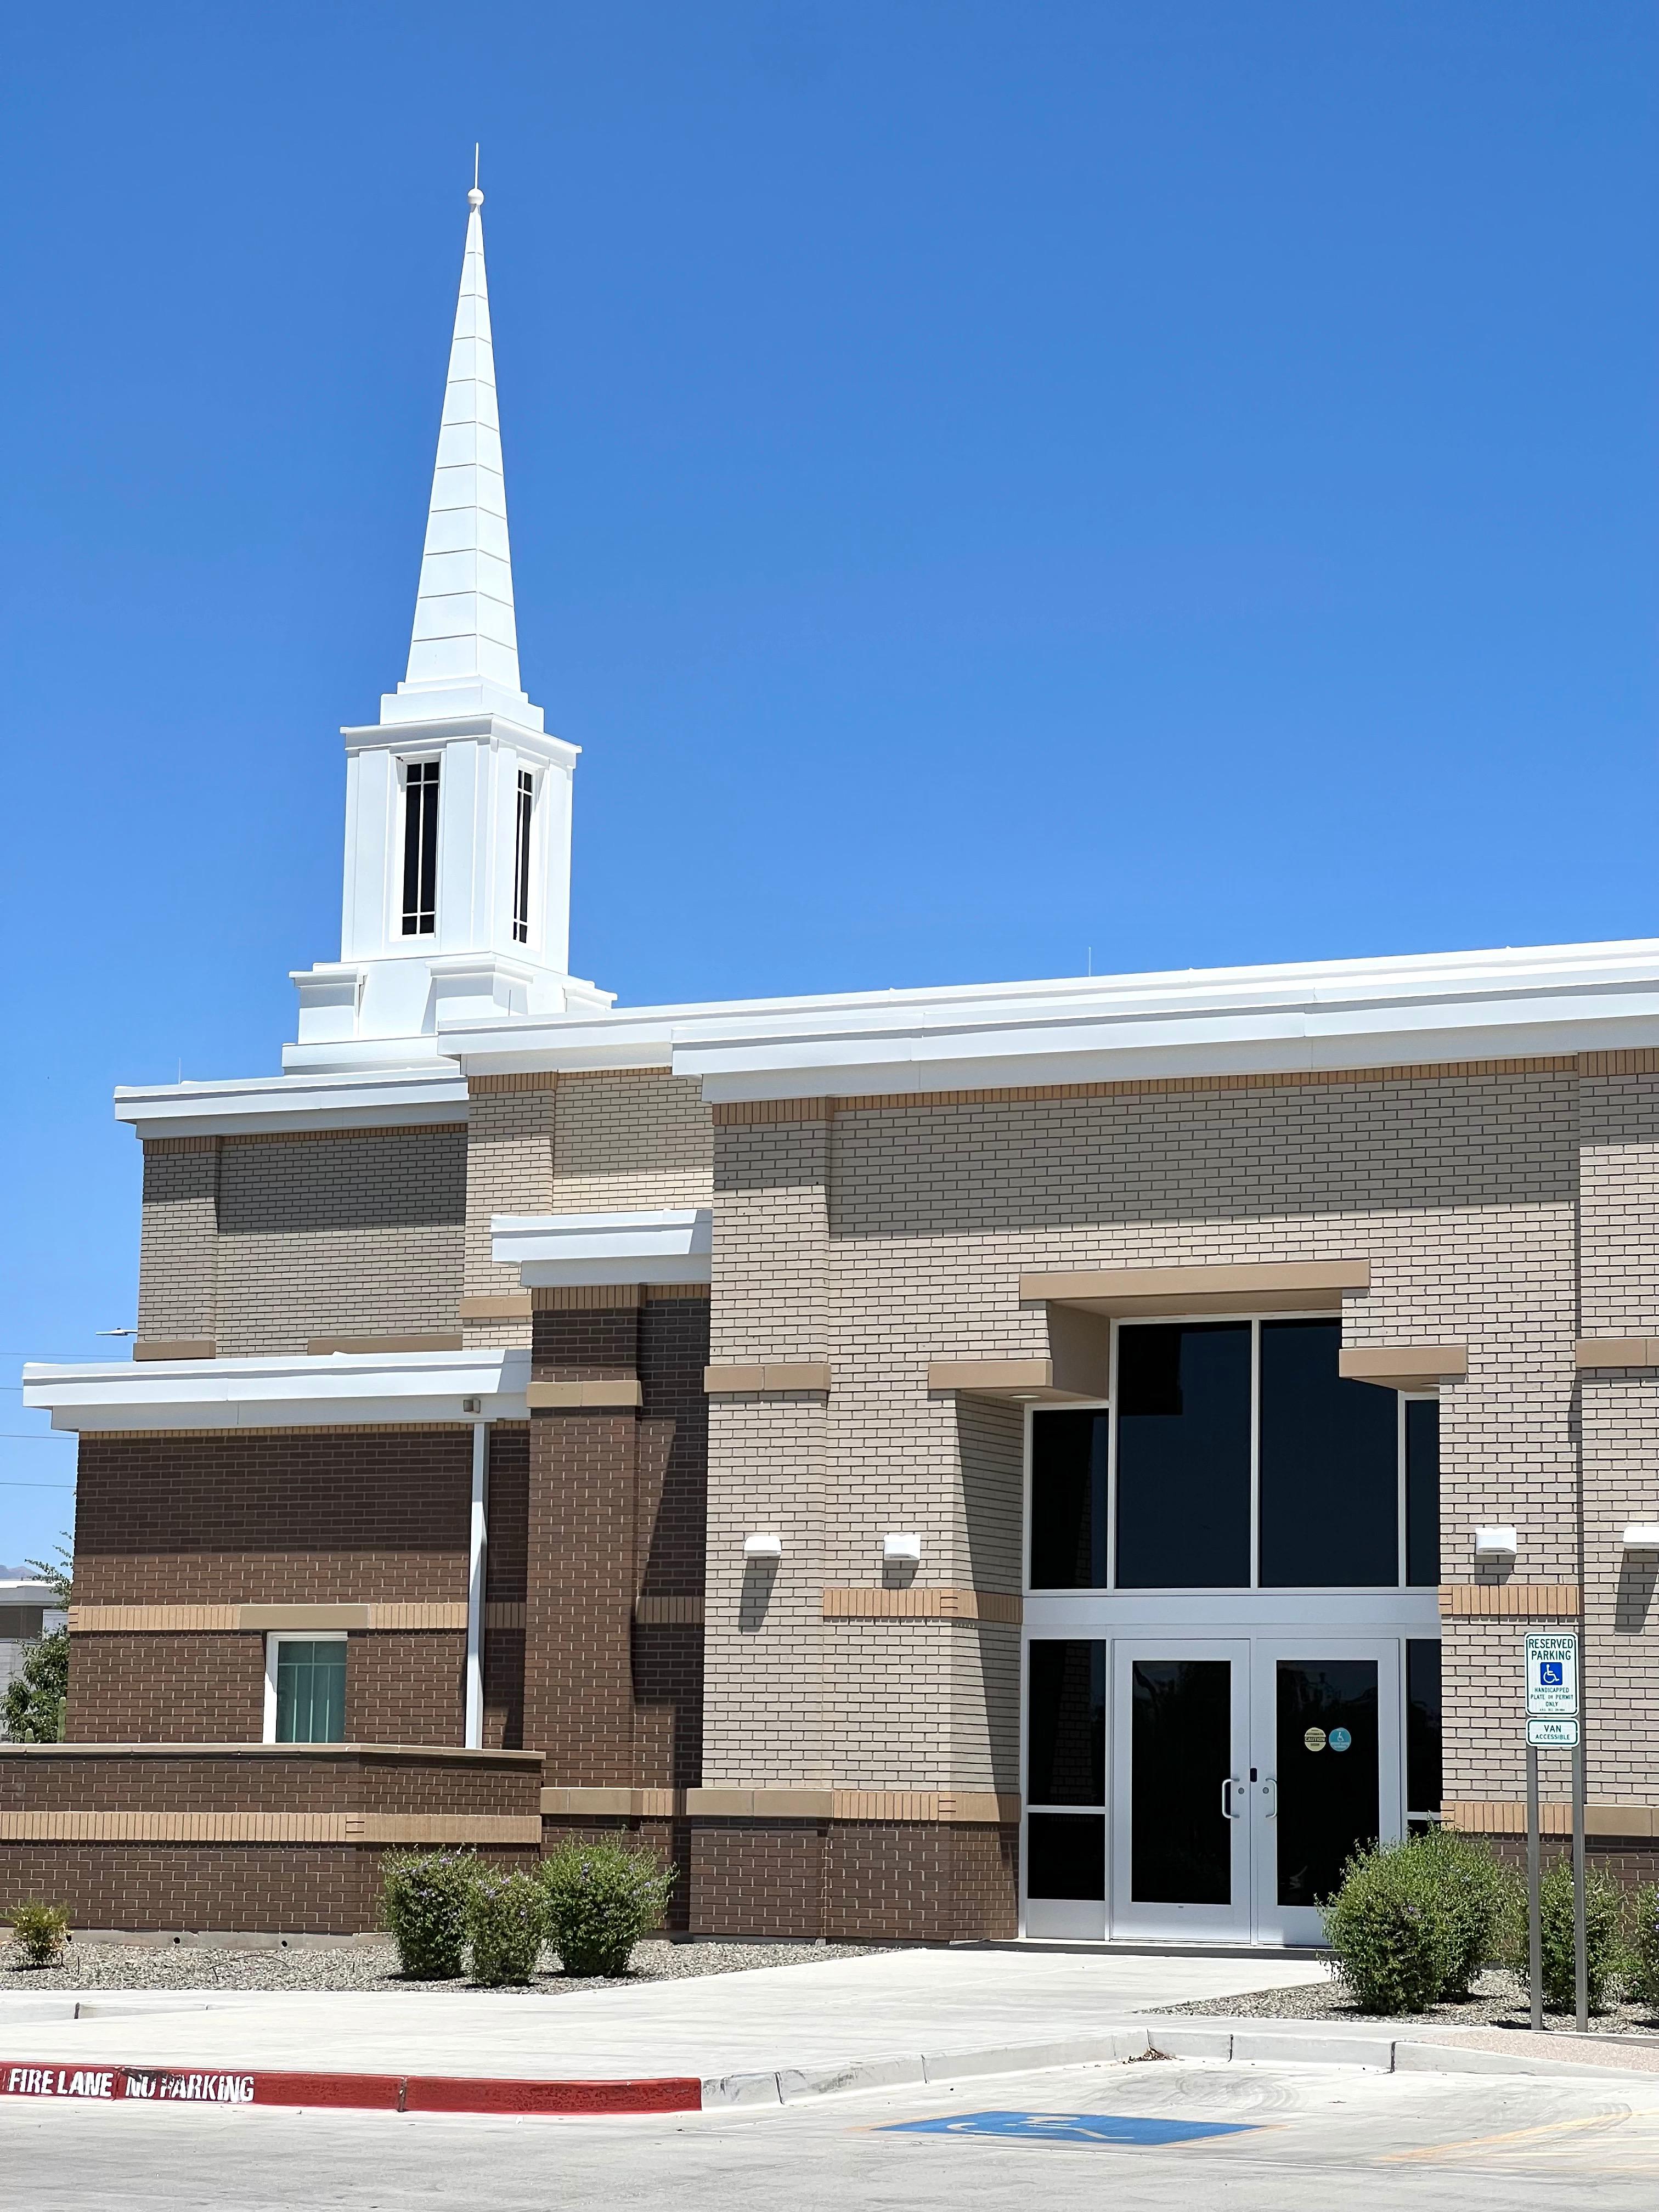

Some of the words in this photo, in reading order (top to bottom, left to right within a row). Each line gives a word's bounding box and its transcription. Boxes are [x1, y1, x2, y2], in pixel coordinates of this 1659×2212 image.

[1528, 1639, 1573, 1649] RESERVED
[1531, 1650, 1571, 1660] PARKING
[8, 2068, 54, 2094] FIRE
[57, 2070, 114, 2097] LANE
[125, 2074, 157, 2097] NO
[160, 2074, 255, 2102] PARKING
